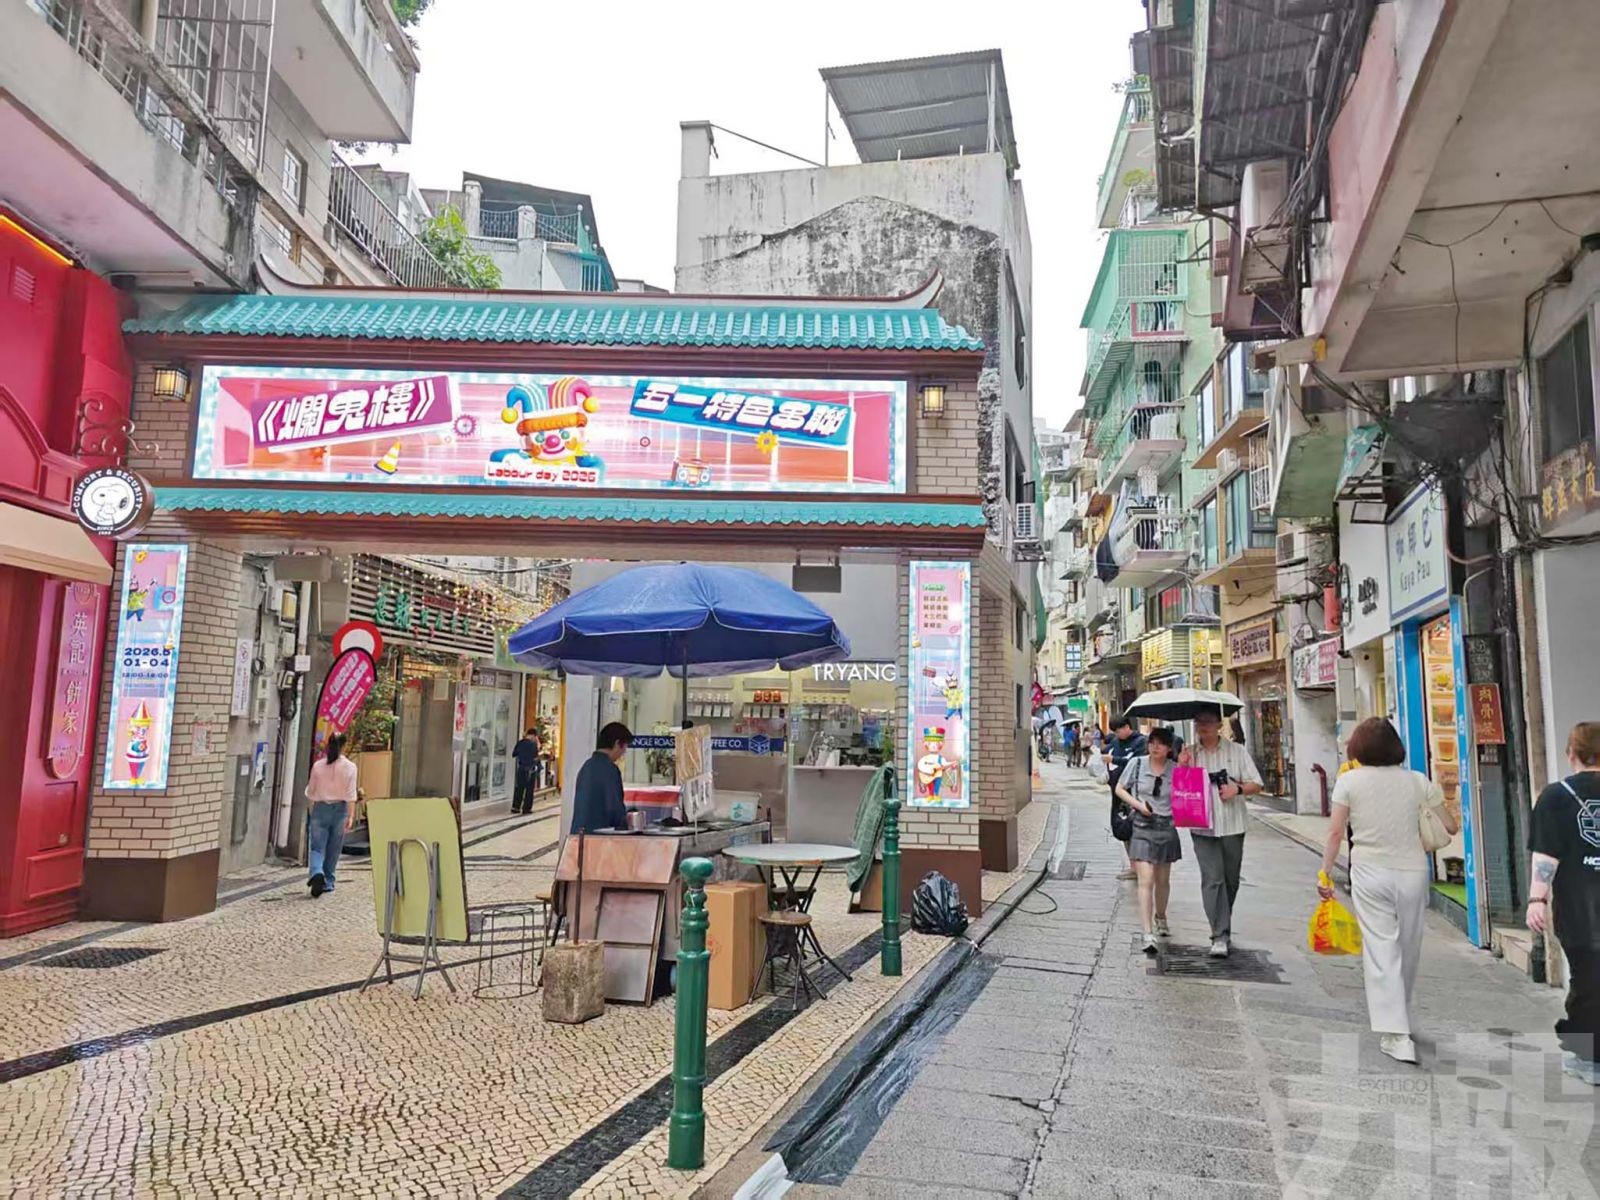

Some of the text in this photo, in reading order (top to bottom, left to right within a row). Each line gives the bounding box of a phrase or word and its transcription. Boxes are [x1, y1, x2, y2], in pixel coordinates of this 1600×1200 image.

[634, 382, 848, 437] 五一特色串聯
[73, 470, 102, 508] COMFORT
[116, 470, 143, 509] SECURITY
[487, 468, 596, 482] Labour day 2026
[811, 662, 897, 682] TRYANG
[1479, 688, 1496, 737] 肉骨茶
